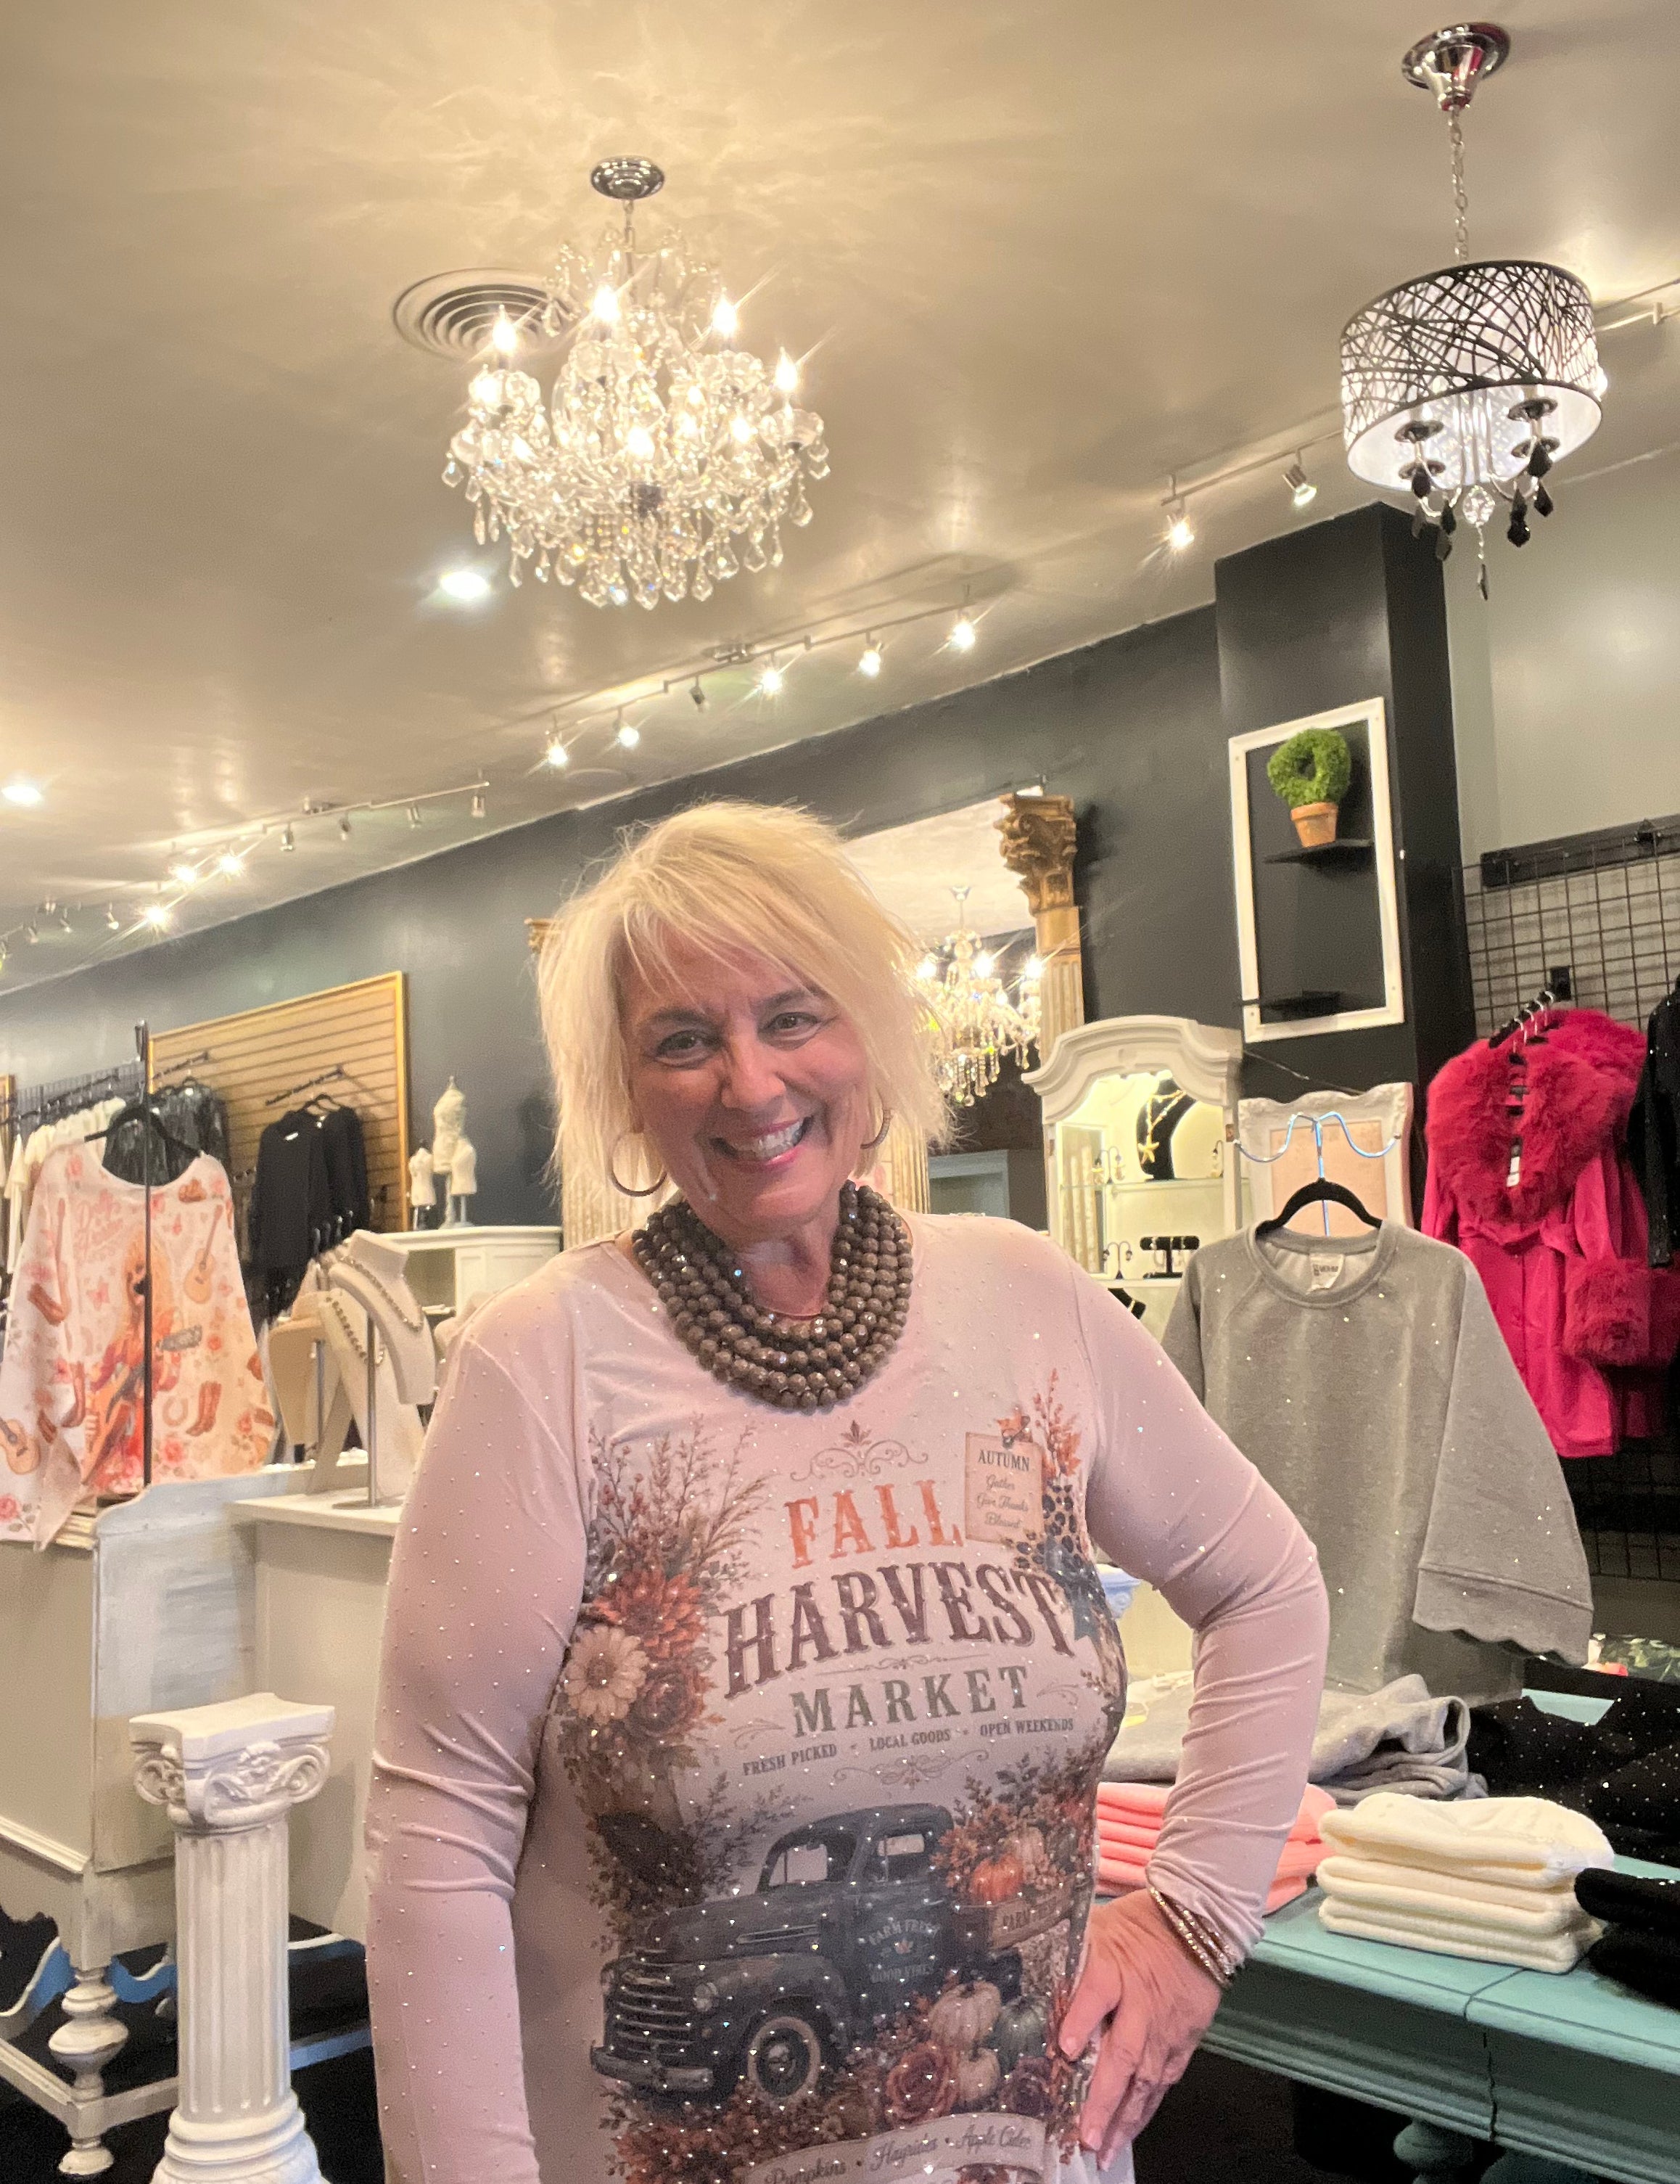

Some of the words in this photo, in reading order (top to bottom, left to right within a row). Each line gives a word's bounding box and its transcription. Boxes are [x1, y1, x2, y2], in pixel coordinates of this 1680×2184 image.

[978, 1449, 1030, 1472] AUTUMN
[784, 1479, 964, 1569] FALL
[724, 1561, 1076, 1700] HARVEST
[789, 1666, 1028, 1738] MARKET
[743, 1754, 786, 1776] FRESH
[791, 1744, 837, 1765] PICKED
[869, 1734, 907, 1752] LOCAL
[911, 1728, 952, 1746] GOODS
[980, 1720, 1011, 1737] OPEN
[1016, 1717, 1074, 1734] WEEKENDS
[870, 2132, 939, 2171] Hayrides
[955, 2123, 997, 2154] Apple
